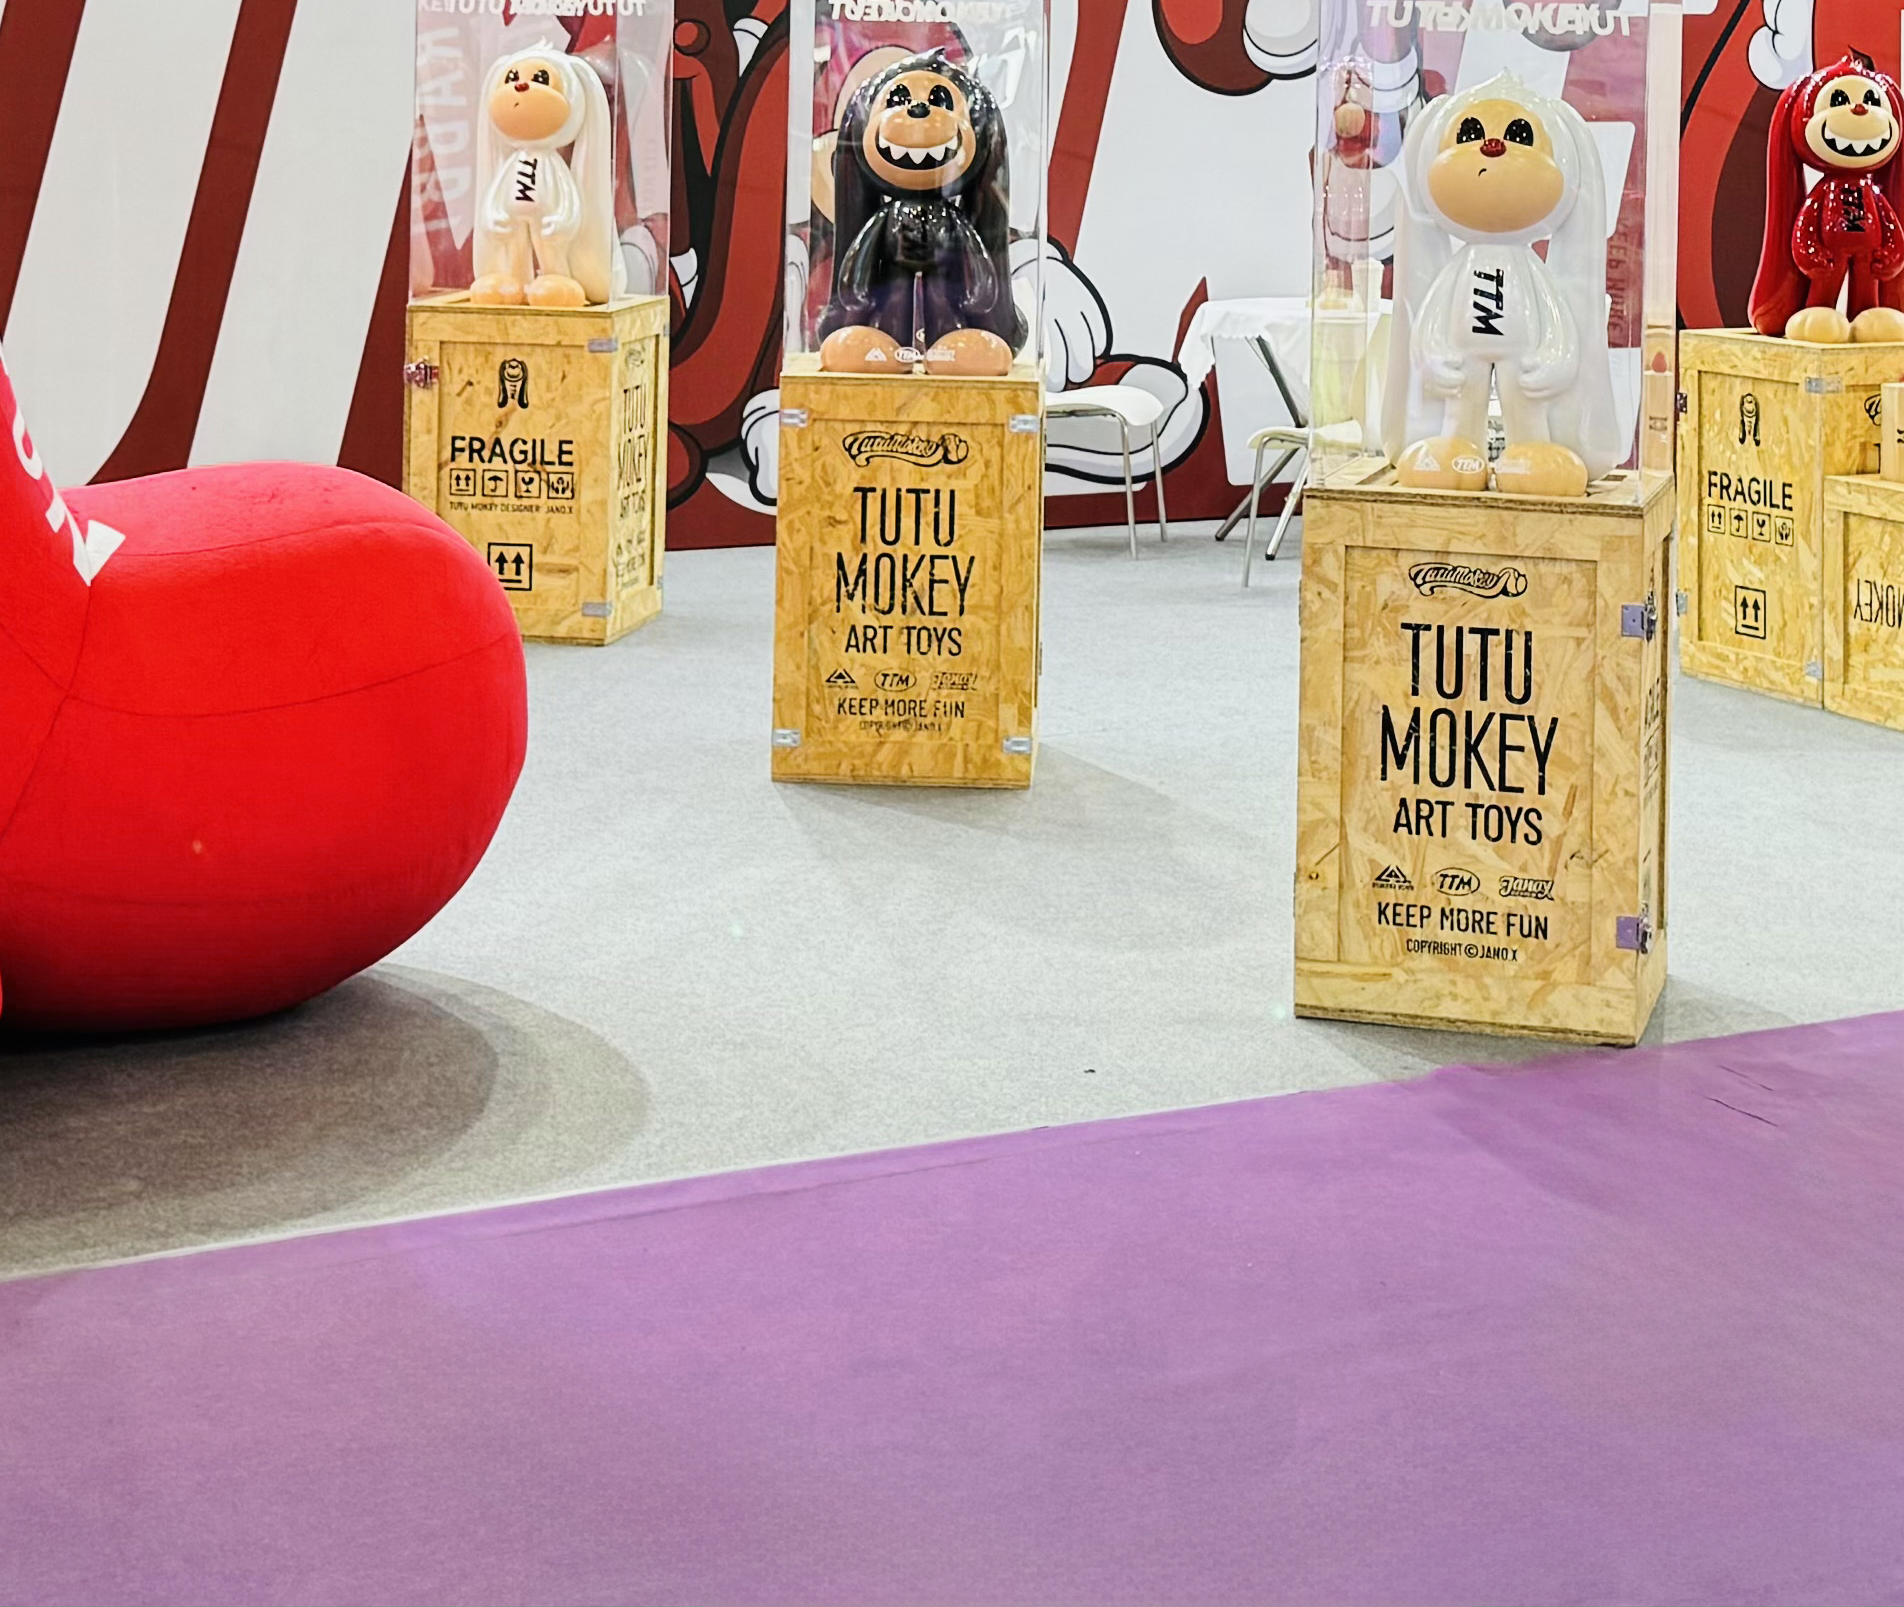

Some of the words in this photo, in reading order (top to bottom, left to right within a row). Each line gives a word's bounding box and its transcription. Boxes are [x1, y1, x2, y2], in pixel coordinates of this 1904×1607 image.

[514, 157, 540, 204] TTM
[1472, 268, 1505, 337] TTM
[449, 435, 575, 468] FRAGILE
[1706, 469, 1795, 513] FRAGILE
[852, 486, 957, 548] TUTU
[834, 551, 976, 618] MOKEY
[844, 625, 894, 655] ART
[901, 625, 963, 657] TOYS
[1400, 621, 1534, 706] TUTU
[880, 672, 910, 687] TTM
[837, 697, 880, 716] KEEP
[884, 698, 928, 718] MORE
[1379, 704, 1560, 797] MOKEY
[1392, 796, 1455, 838] ART
[1466, 802, 1544, 846] TOYS
[1439, 874, 1473, 892] TTM
[1377, 901, 1432, 929] KEEP
[1439, 906, 1499, 936] MORE
[1506, 912, 1548, 941] FUN
